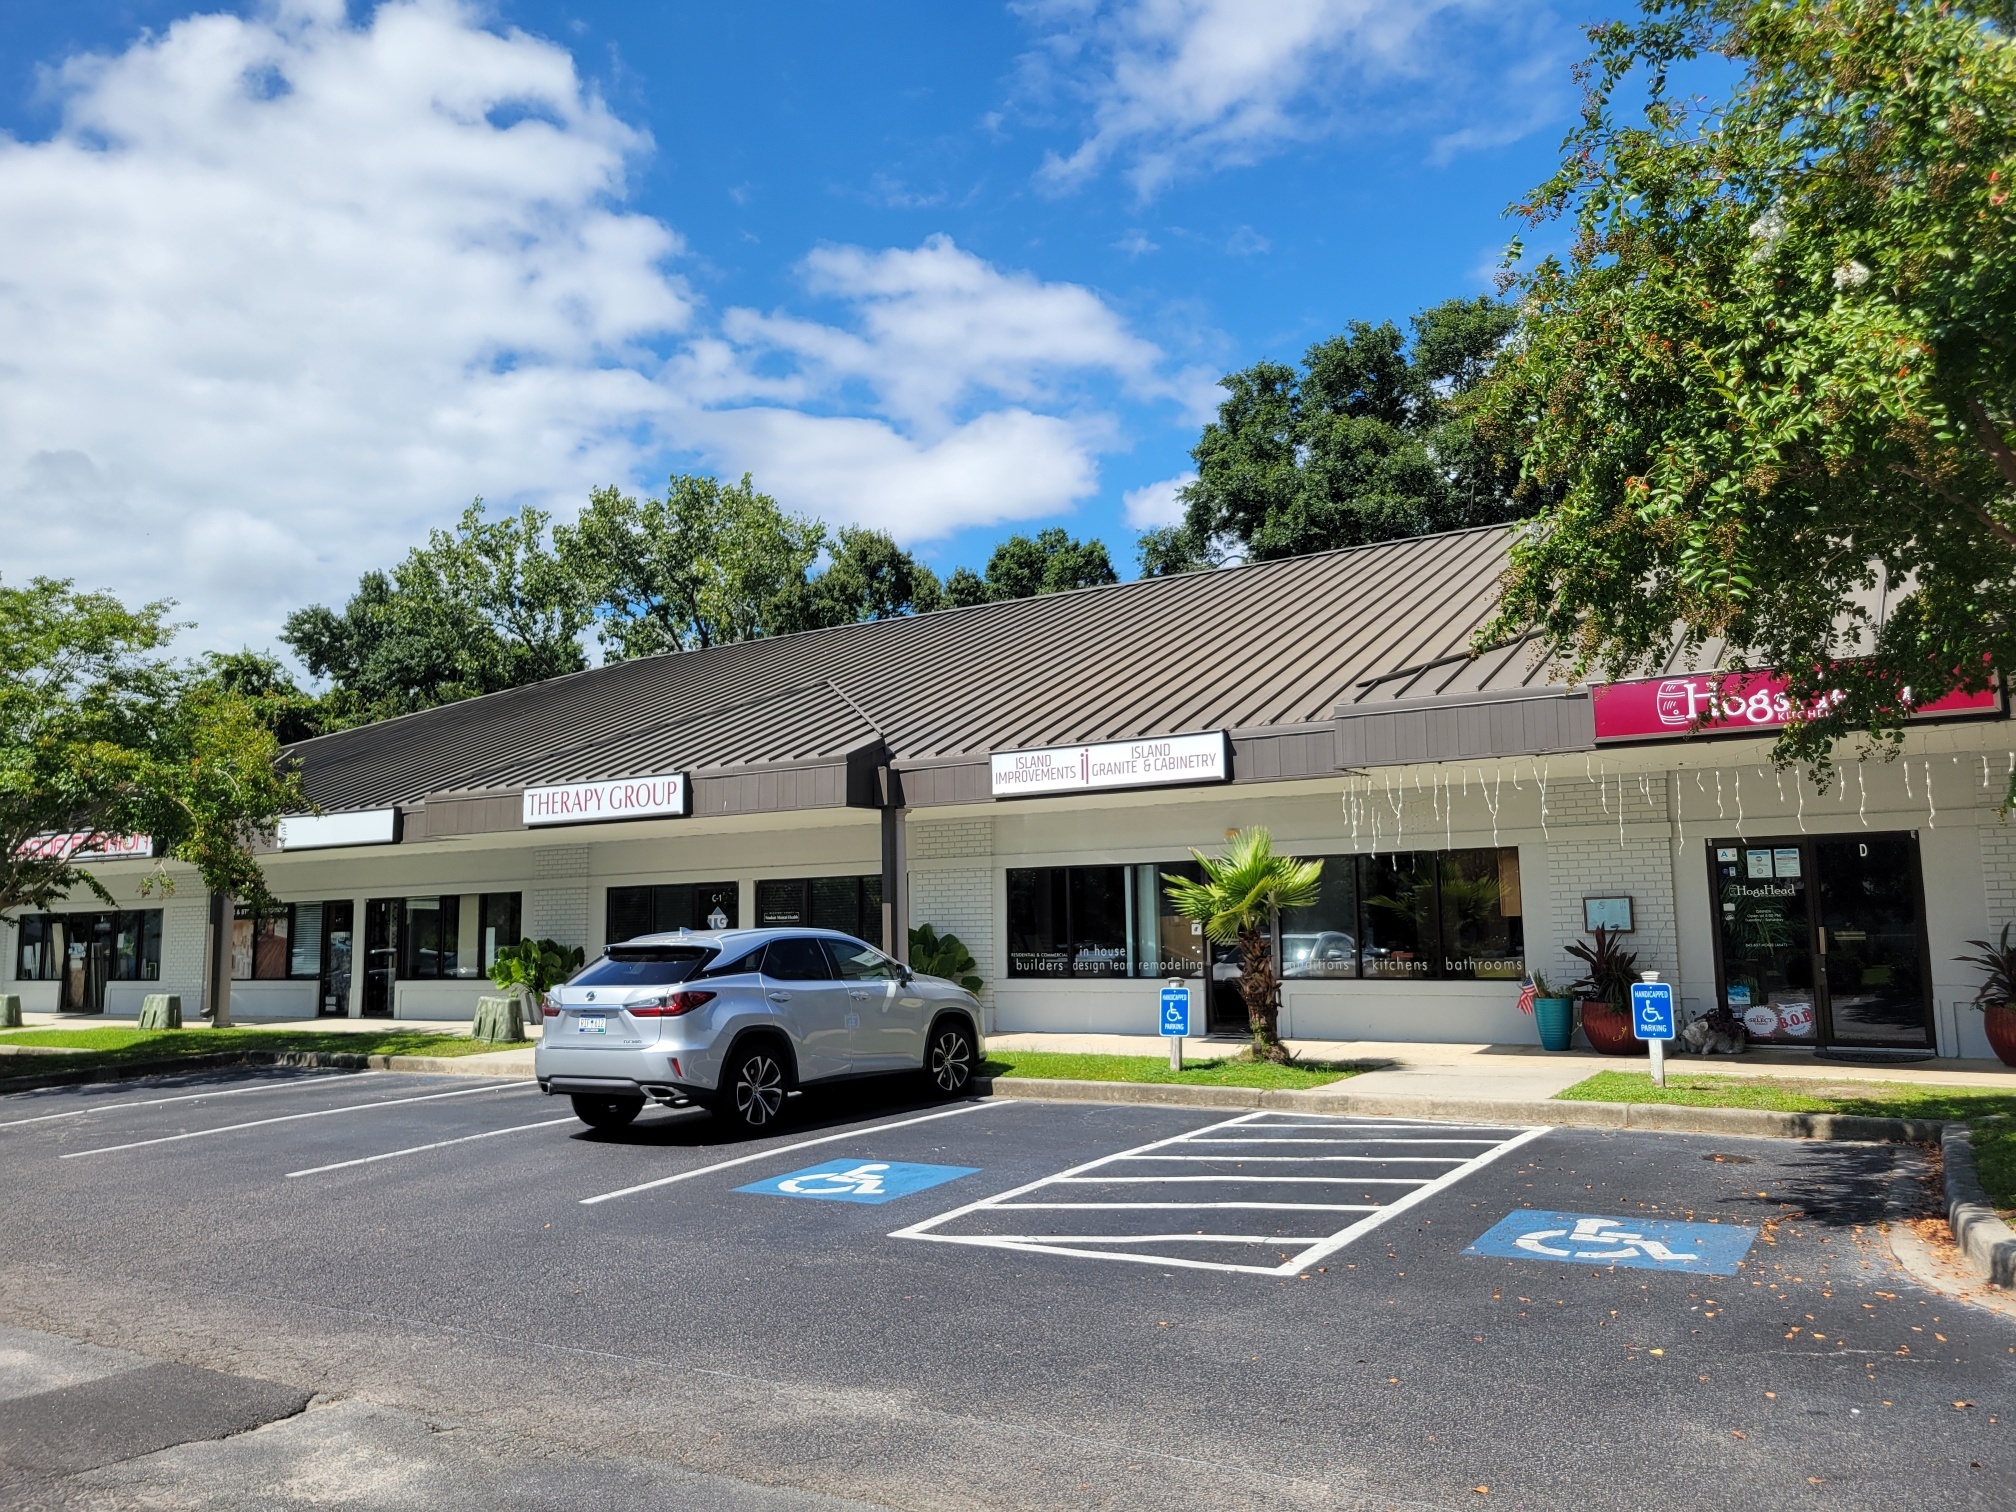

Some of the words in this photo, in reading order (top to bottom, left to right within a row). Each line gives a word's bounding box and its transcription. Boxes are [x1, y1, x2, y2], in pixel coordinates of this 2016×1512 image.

[1131, 743, 1171, 760] ISLAND
[1015, 754, 1052, 770] ISLAND
[1092, 760, 1138, 777] GRANITE
[1143, 758, 1151, 772] &
[1154, 753, 1217, 772] CABINETRY
[995, 765, 1077, 785] IMPROVEMENTS
[528, 787, 605, 816] THERAPY
[609, 781, 677, 810] GROUP
[1859, 844, 1868, 857] D
[711, 894, 722, 903] C-1
[1736, 884, 1795, 898] HogsHead
[1080, 945, 1089, 956] in
[1094, 944, 1126, 957] house
[1016, 959, 1064, 971] builders
[1072, 960, 1105, 974] design
[1138, 957, 1203, 972] remodeling
[1372, 956, 1428, 971] kitchens
[1445, 956, 1523, 971] bathrooms
[1634, 990, 1668, 998] HANDICAPPED
[1640, 1024, 1667, 1032] PARKING
